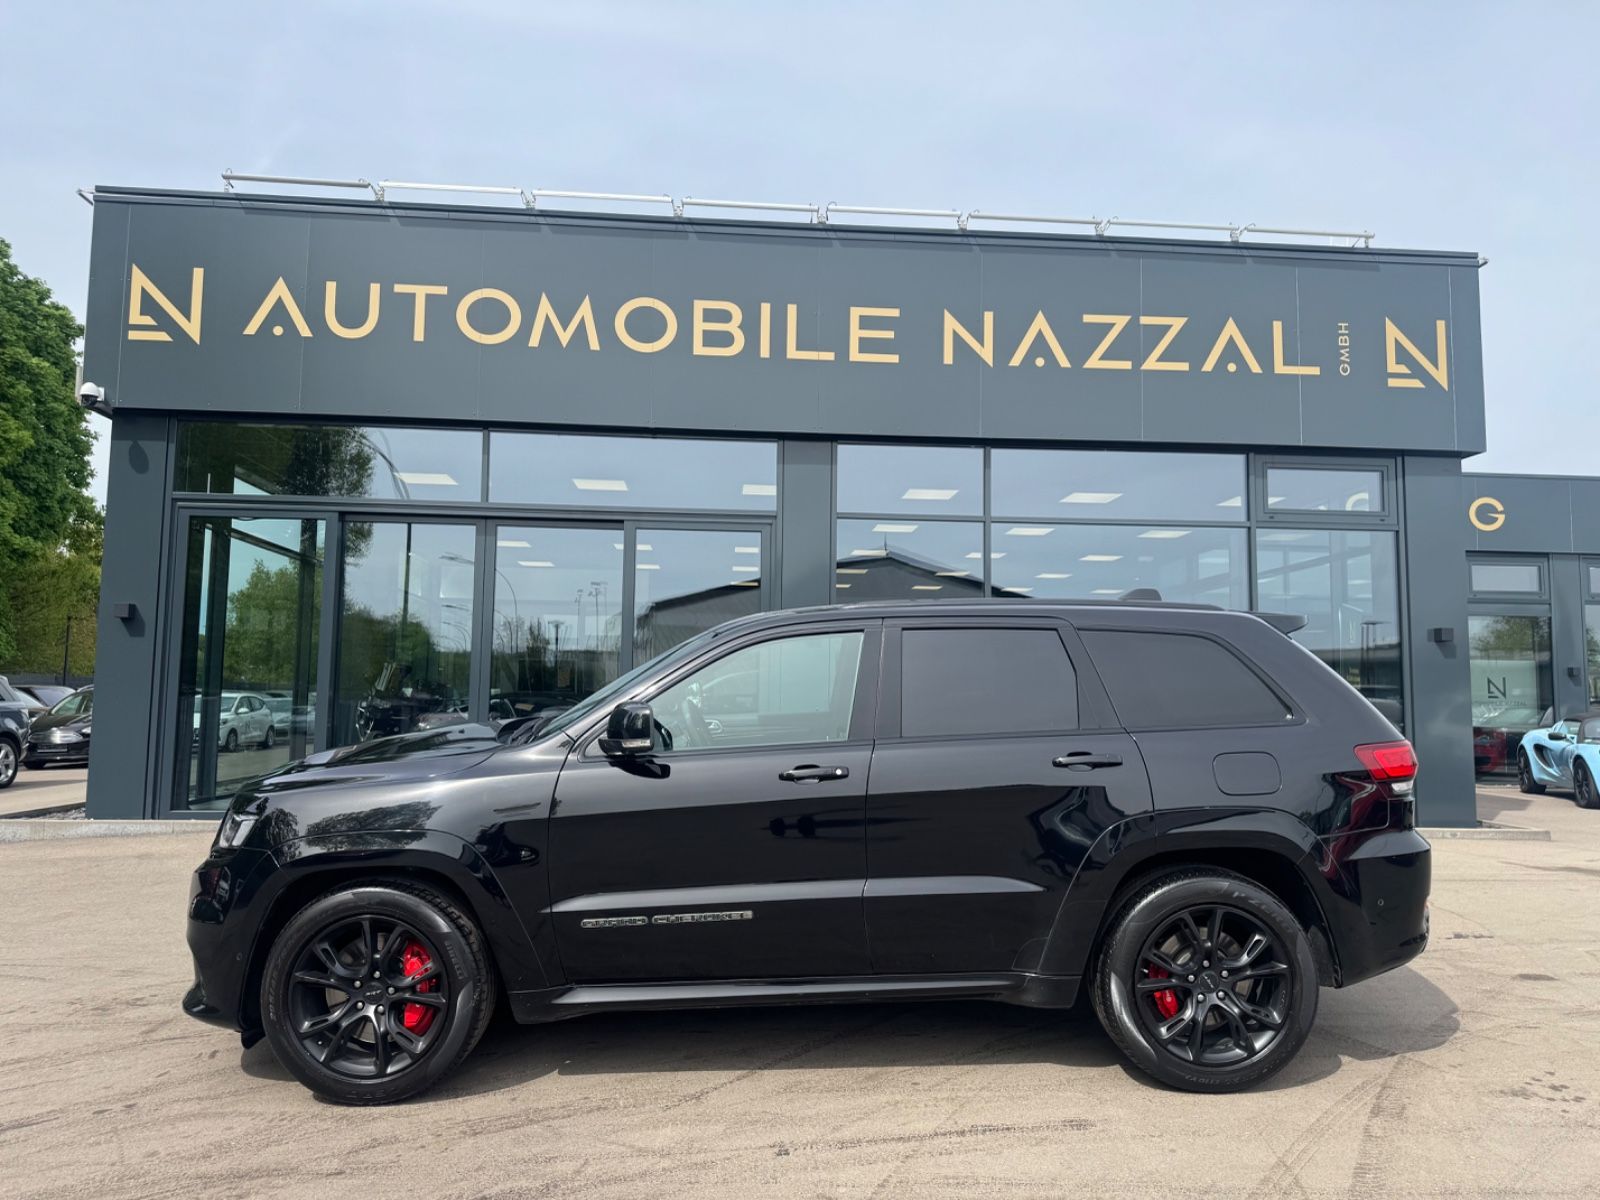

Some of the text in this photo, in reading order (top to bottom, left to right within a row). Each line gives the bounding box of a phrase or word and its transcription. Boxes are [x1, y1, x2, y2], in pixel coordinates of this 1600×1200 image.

[243, 276, 900, 364] AUTOMOBILE
[943, 309, 1321, 376] NAZZAL
[1338, 322, 1351, 376] GMBH
[1468, 496, 1506, 532] G
